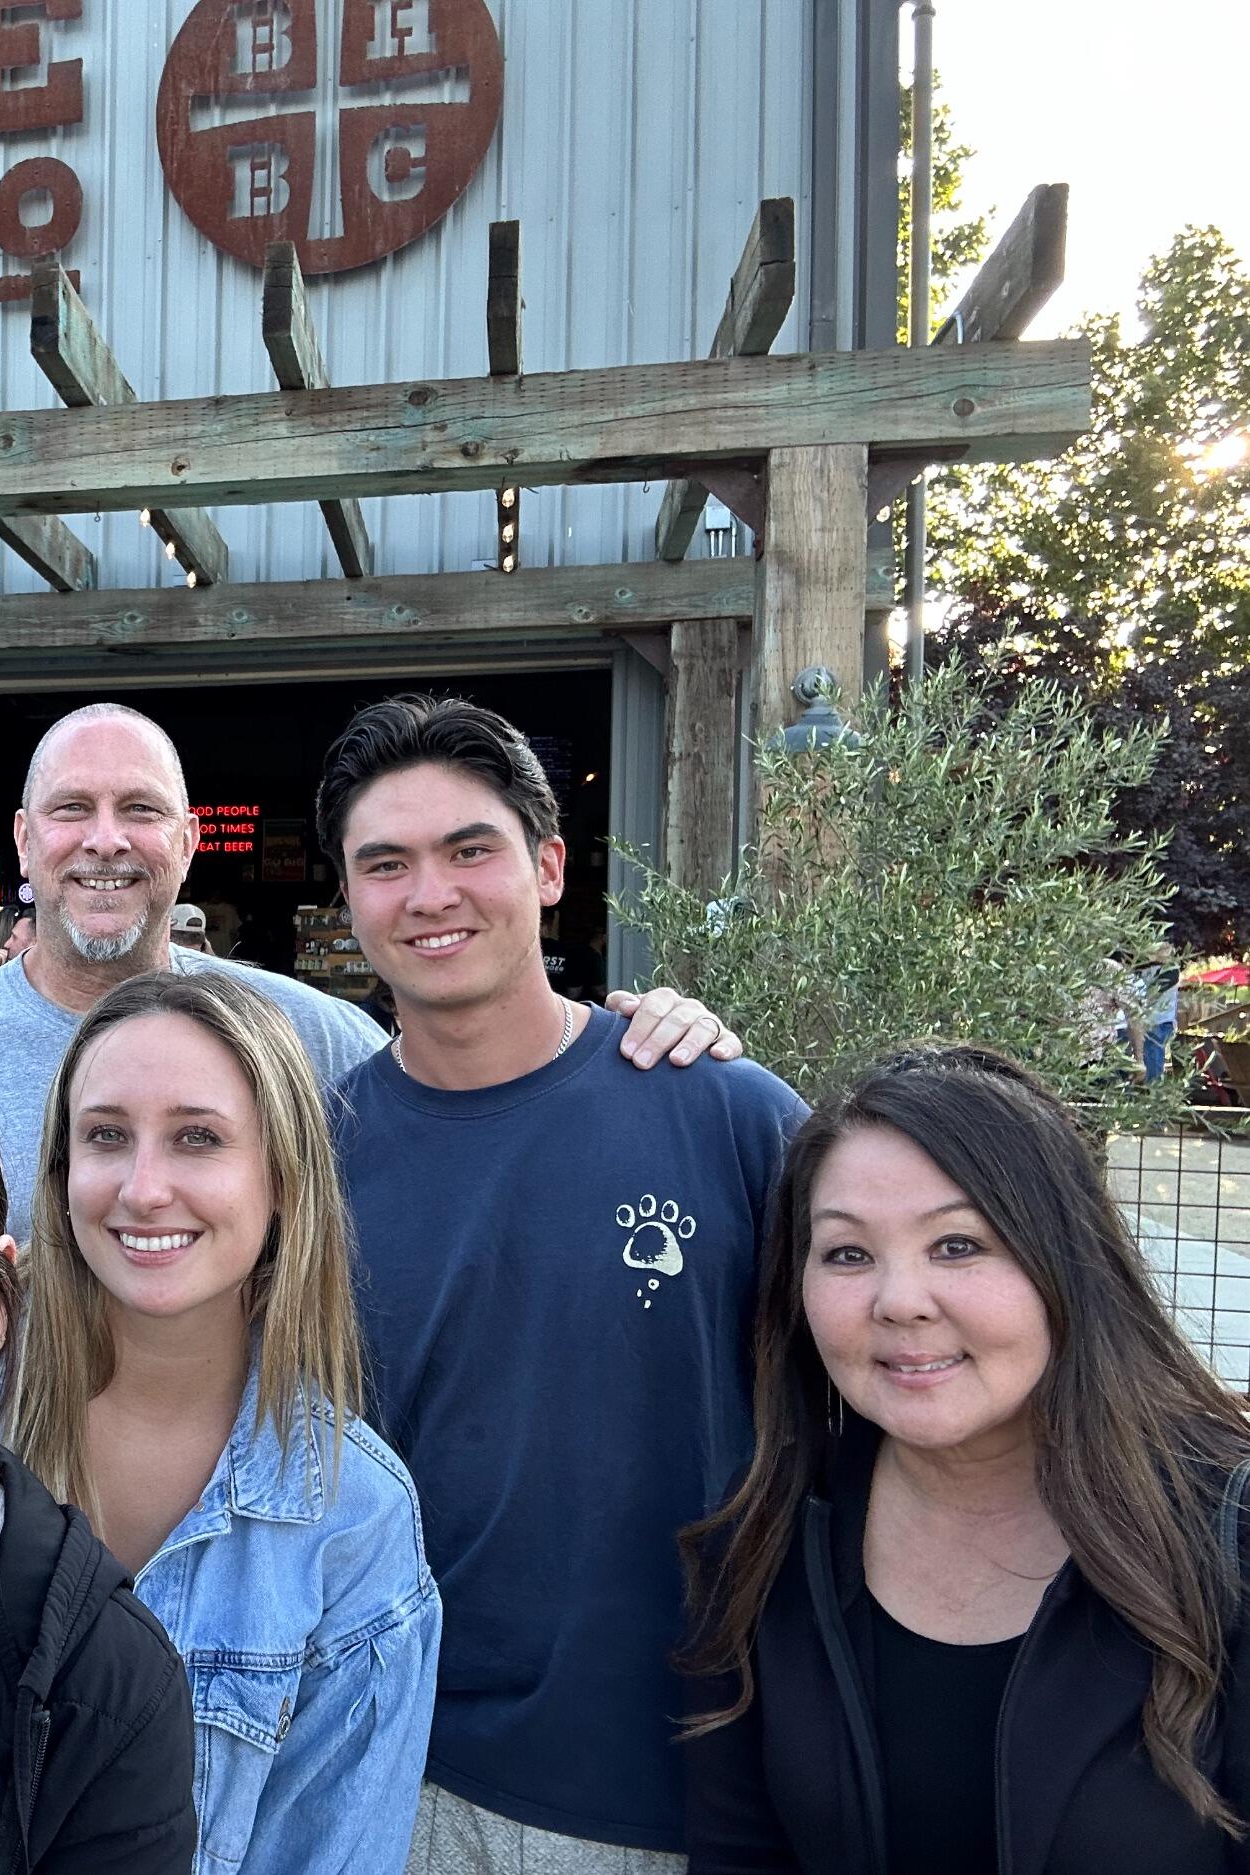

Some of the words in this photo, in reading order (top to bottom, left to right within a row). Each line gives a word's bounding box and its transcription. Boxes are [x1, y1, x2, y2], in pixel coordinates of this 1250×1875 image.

[230, 0, 293, 75] B
[226, 141, 291, 220] B
[366, 123, 428, 202] C
[189, 806, 213, 816] OOD
[217, 806, 260, 816] PEOPLE
[199, 824, 217, 834] OD
[220, 824, 255, 834] TIMES
[199, 842, 220, 852] EAT
[224, 842, 253, 852] BEER
